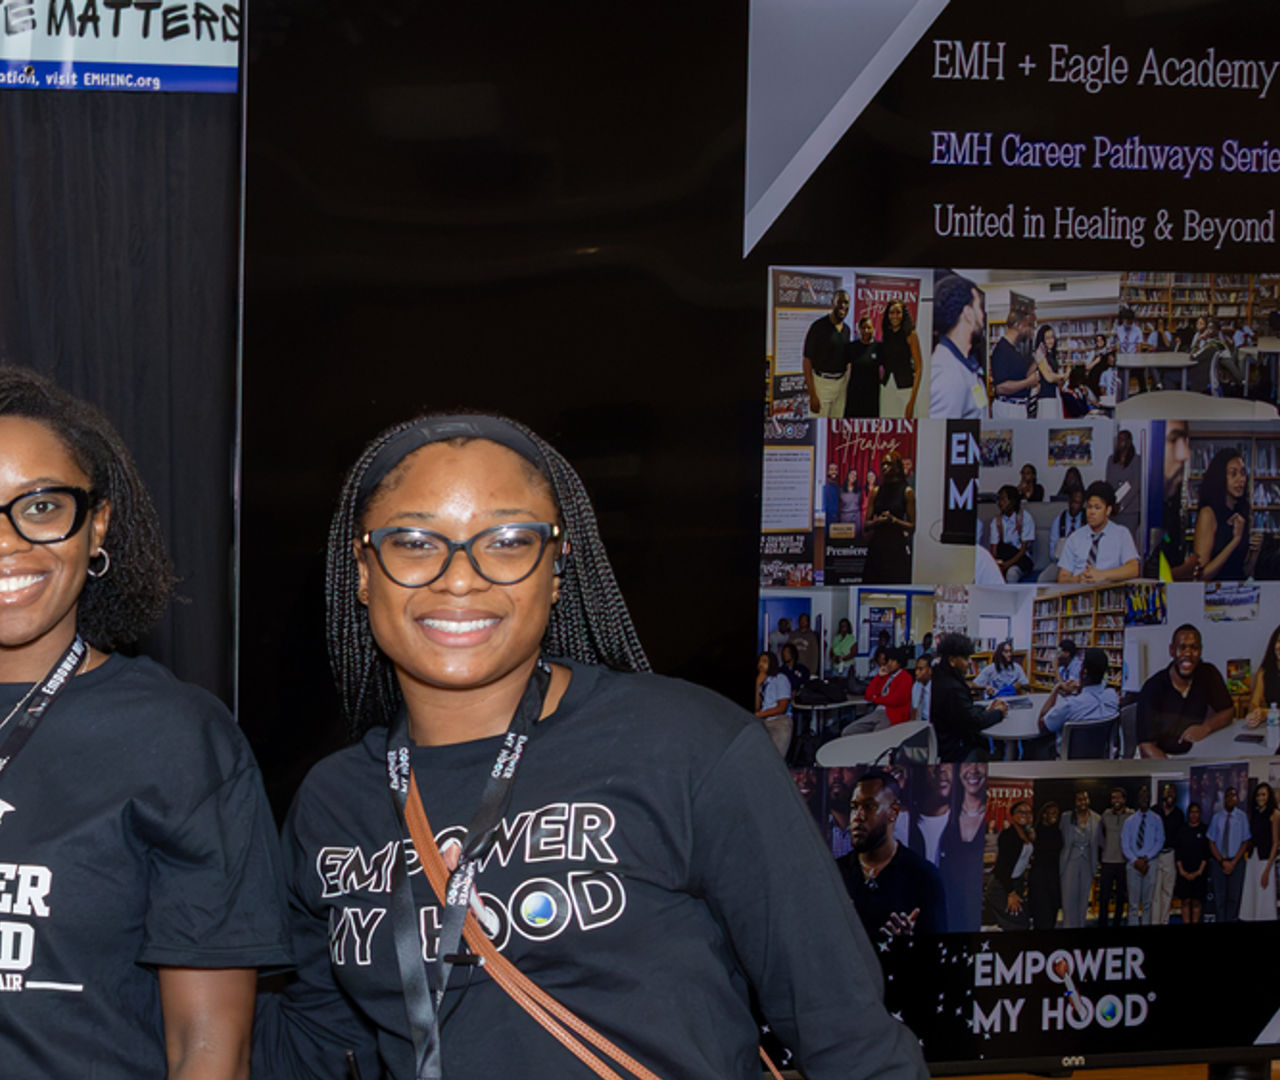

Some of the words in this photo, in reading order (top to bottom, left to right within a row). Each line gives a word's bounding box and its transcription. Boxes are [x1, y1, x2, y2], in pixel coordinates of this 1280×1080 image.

[45, 71, 78, 87] visit
[83, 72, 161, 90] EMHINC.org
[932, 40, 1006, 80] EMH
[1048, 43, 1129, 93] Eagle
[1137, 47, 1280, 98] Academy
[930, 131, 993, 165] EMH
[1001, 132, 1086, 168] Career
[1092, 135, 1214, 178] Pathways
[933, 203, 1014, 238] United
[1023, 206, 1045, 239] in
[1054, 206, 1146, 248] Healing
[1154, 209, 1173, 241] &
[1182, 209, 1276, 250] Beyond
[41, 651, 79, 695] Empower
[975, 946, 1146, 986] EMPOWER
[973, 998, 1026, 1034] MY
